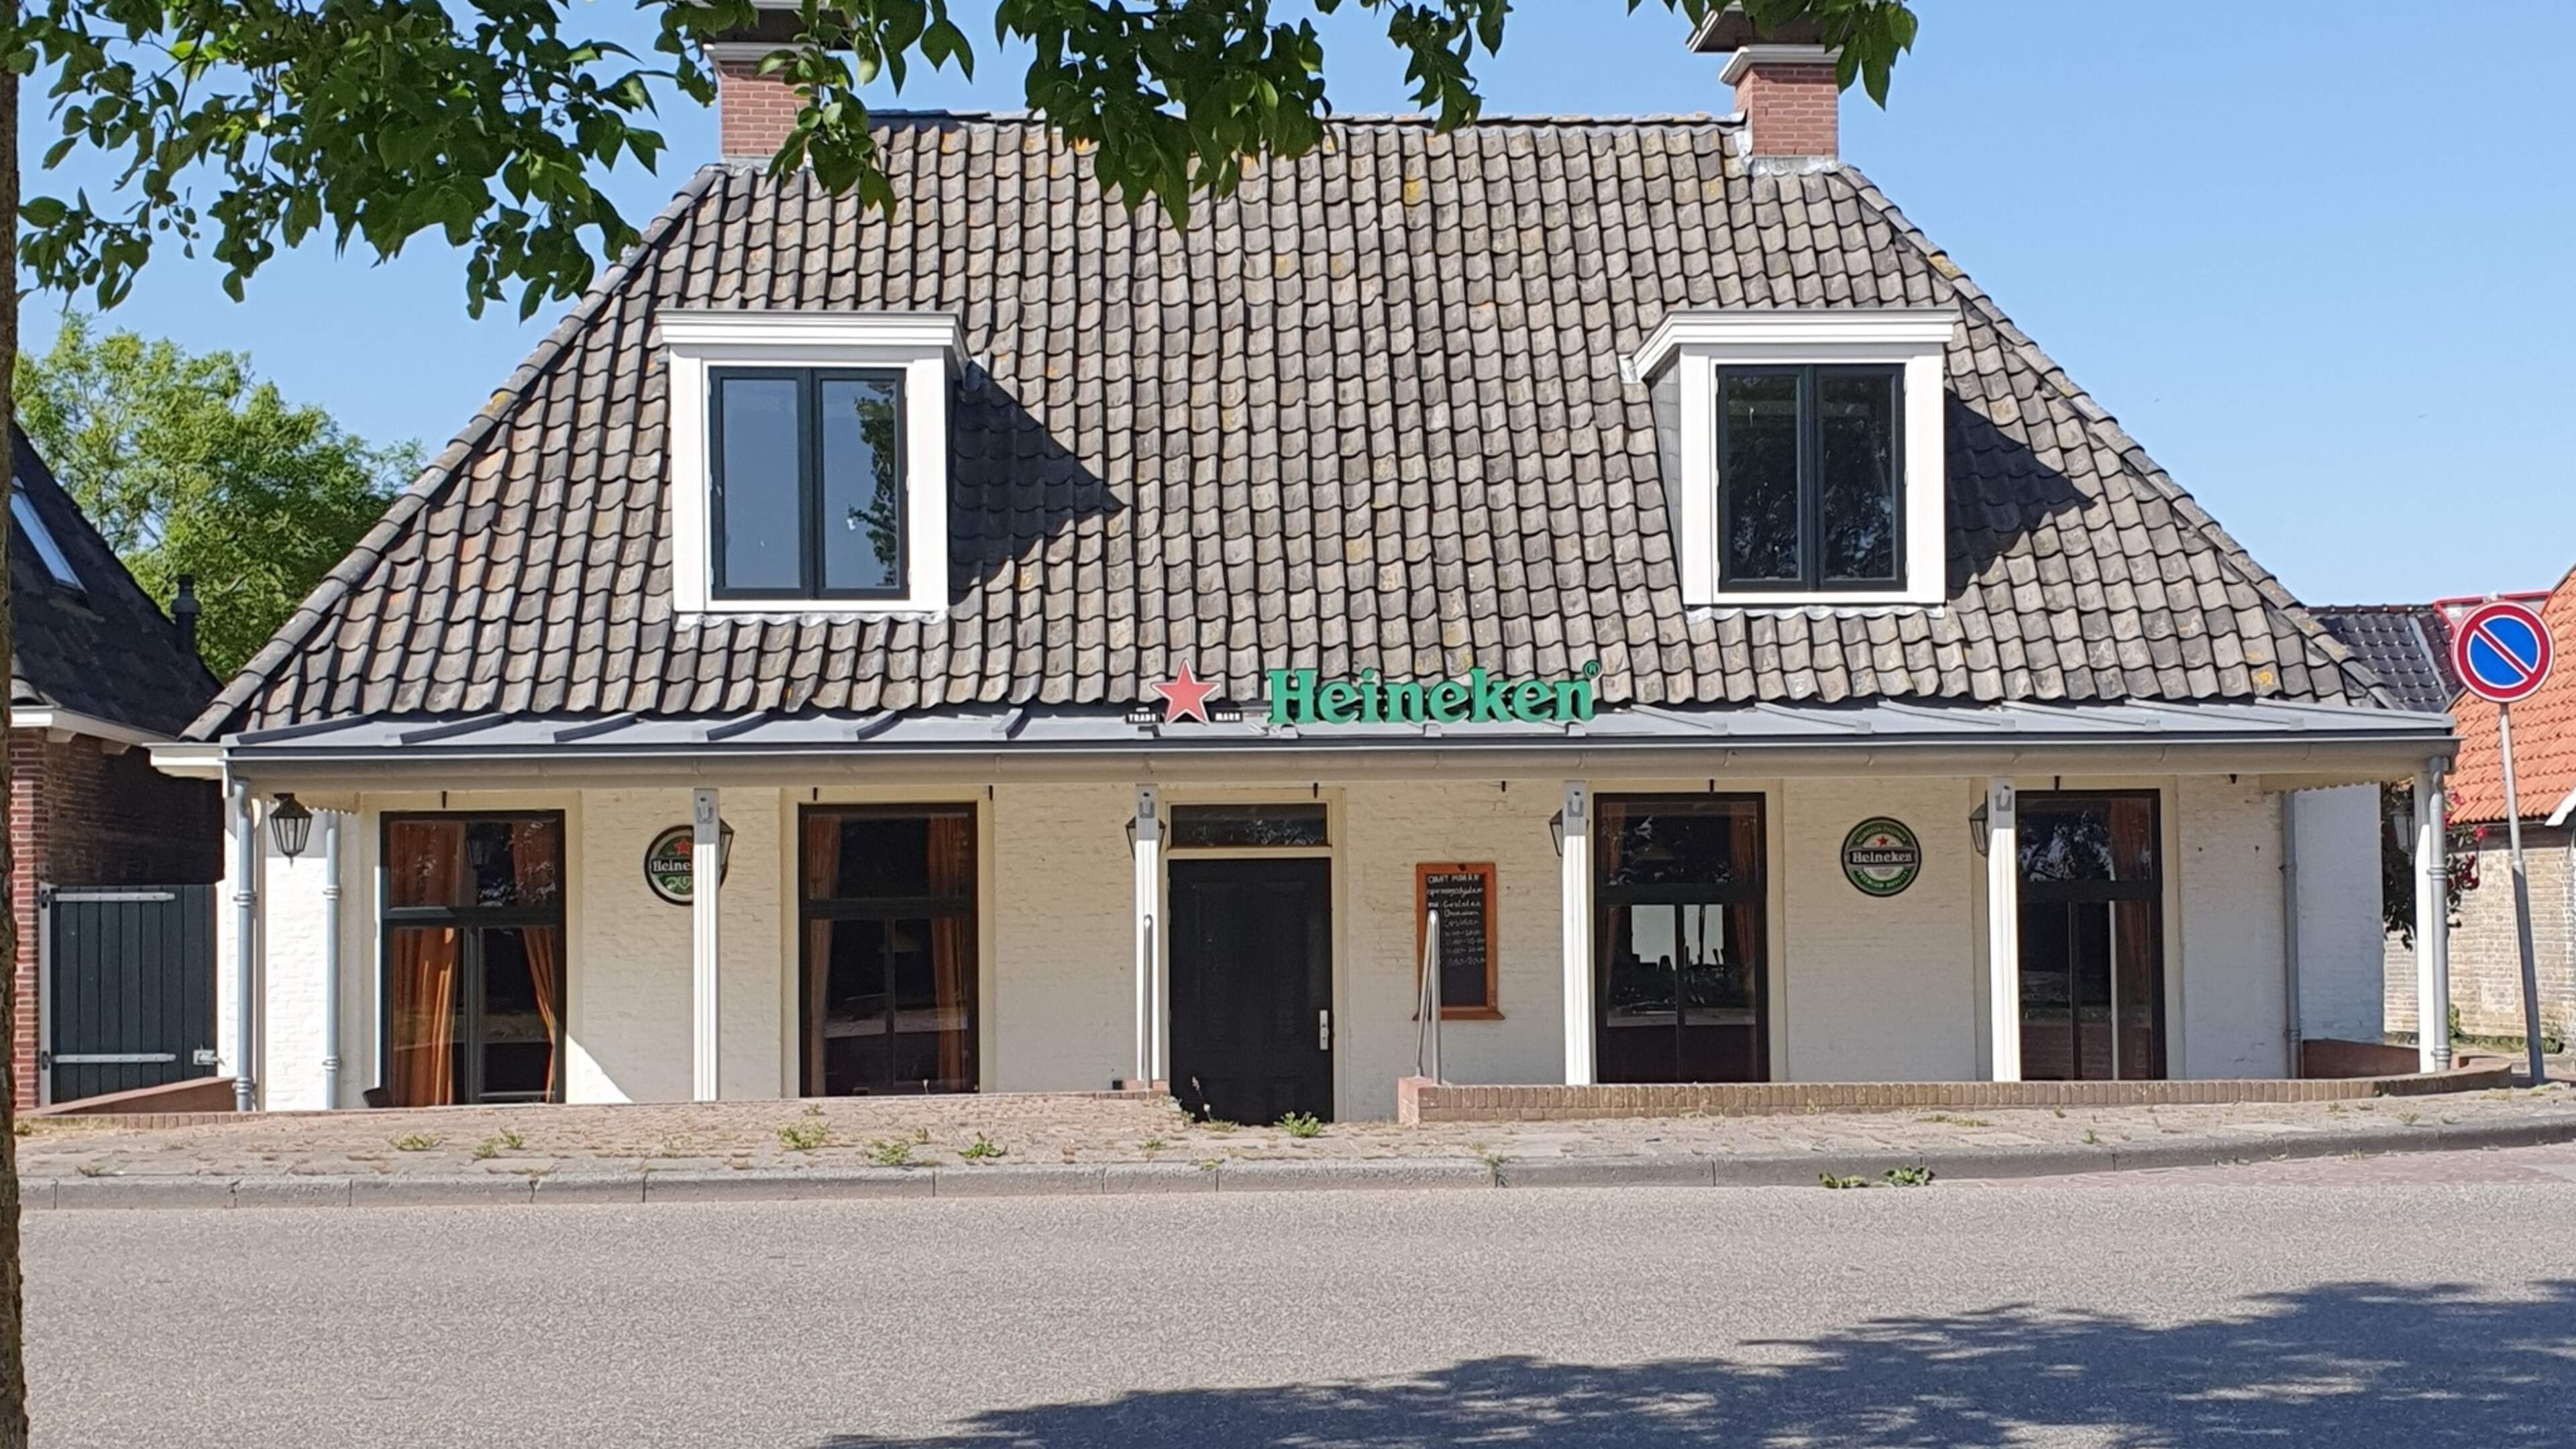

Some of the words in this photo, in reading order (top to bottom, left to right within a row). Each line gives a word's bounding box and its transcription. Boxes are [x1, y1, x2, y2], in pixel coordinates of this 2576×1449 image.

[1128, 713, 1157, 722] TRADE
[1852, 851, 1913, 863] Heineken
[653, 859, 692, 872] Heine
